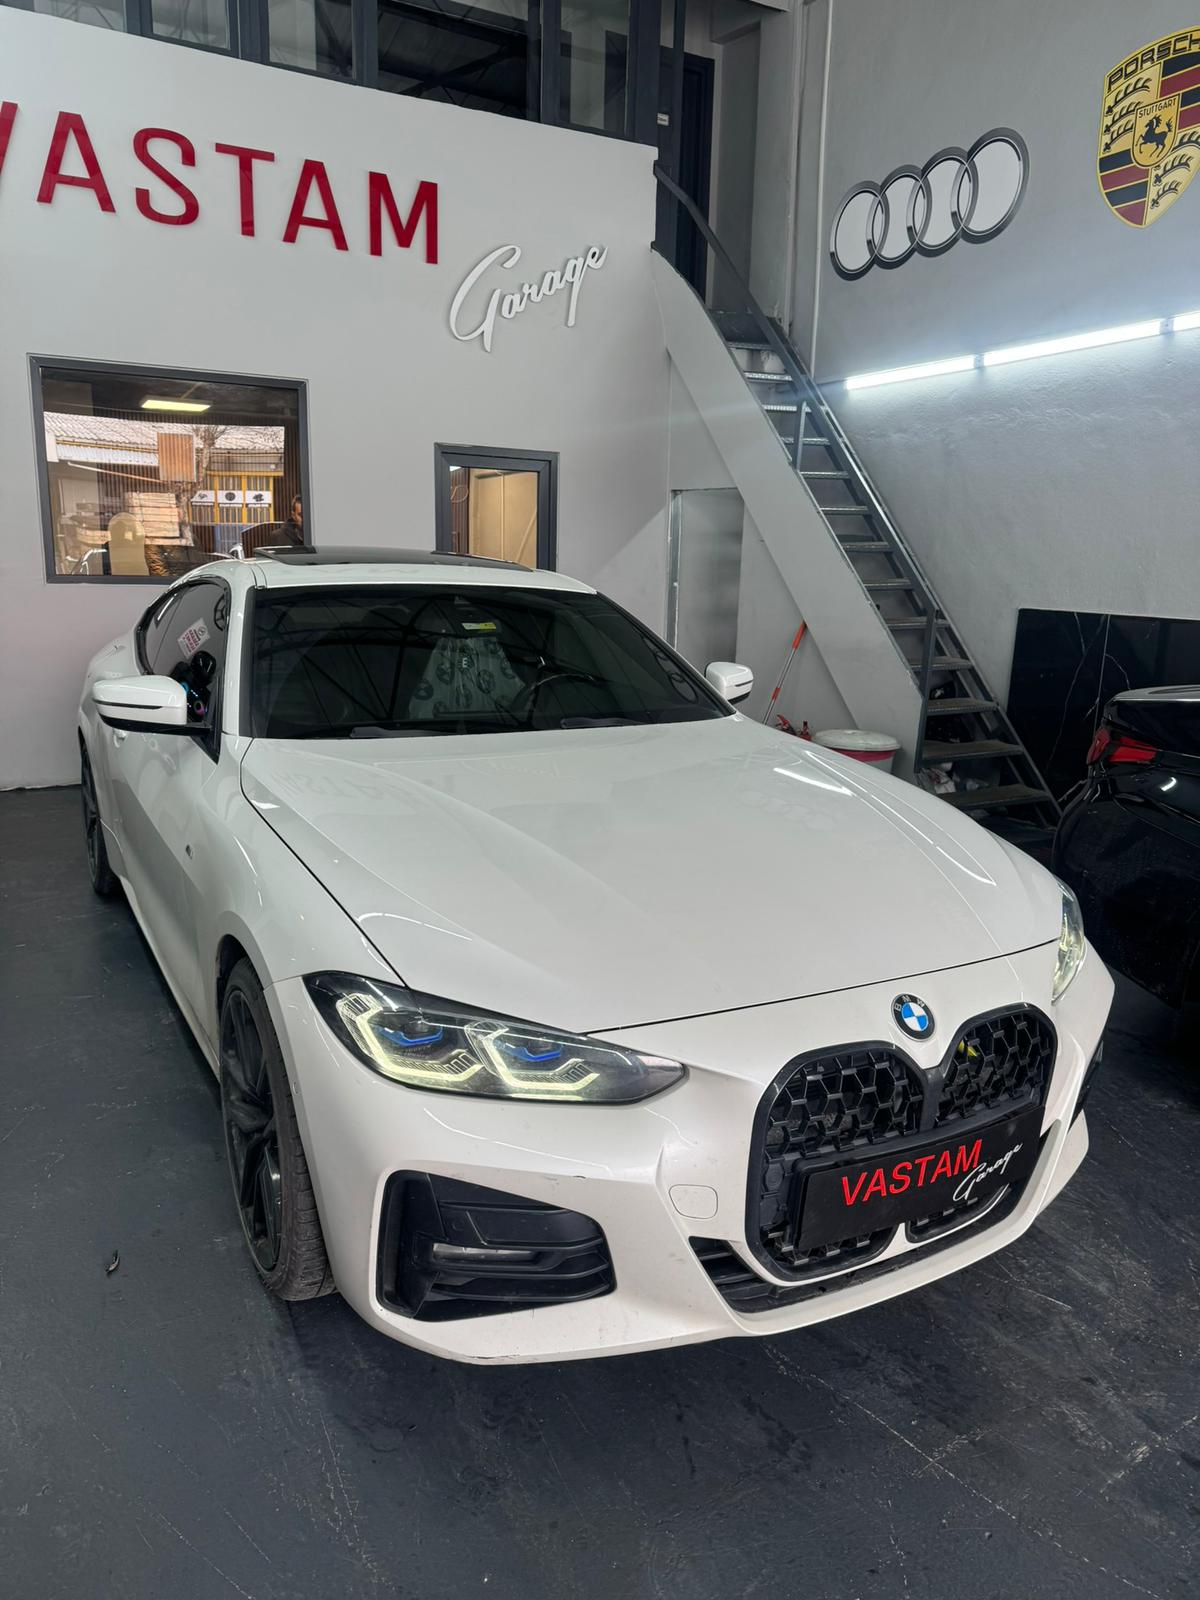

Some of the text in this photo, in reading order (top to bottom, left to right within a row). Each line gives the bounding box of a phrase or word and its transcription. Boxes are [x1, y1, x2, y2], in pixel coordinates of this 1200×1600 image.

[1138, 97, 1177, 119] STUTTGART
[449, 244, 609, 353] Garage
[894, 995, 926, 1012] BMW
[842, 1139, 983, 1206] VASTAM
[953, 1142, 1023, 1202] Garage
